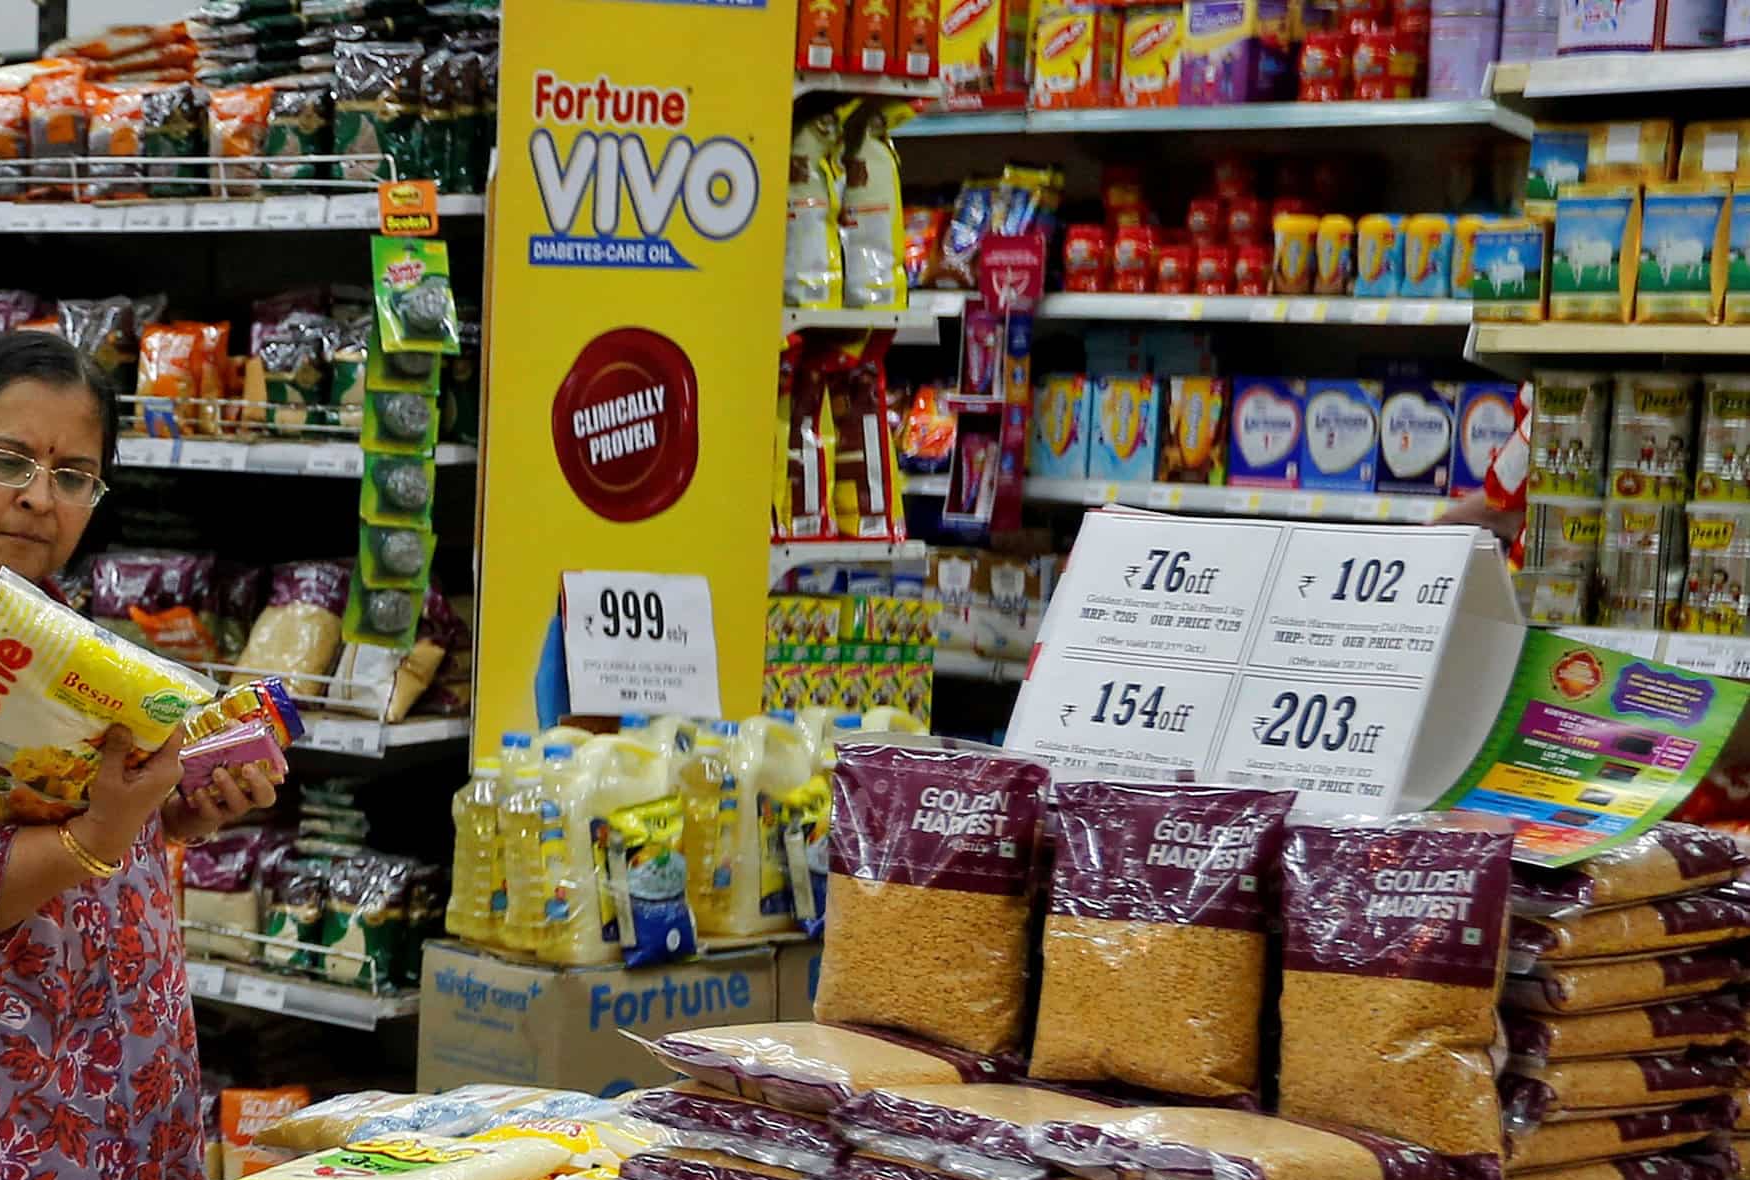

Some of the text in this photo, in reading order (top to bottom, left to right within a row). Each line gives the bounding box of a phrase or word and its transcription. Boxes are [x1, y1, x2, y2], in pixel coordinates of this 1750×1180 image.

[534, 72, 686, 128] Fortune
[529, 128, 760, 242] VIVO
[533, 240, 675, 264] DIABETES-CARE OIL
[573, 384, 666, 438] CLINICALLY
[588, 418, 656, 465] PROVEN
[1141, 549, 1191, 593] 76
[1185, 567, 1220, 594] off
[1331, 558, 1405, 602] 102
[1416, 576, 1455, 605] off
[599, 588, 665, 641] 999
[1079, 607, 1109, 621] MRP:
[1150, 614, 1172, 627] OUR
[1176, 616, 1212, 630] PRICE
[1274, 630, 1305, 645] MRP:
[1342, 636, 1365, 649] OUR
[1368, 637, 1403, 650] PRICE
[62, 670, 123, 712] Besan
[1090, 680, 1166, 729] 154
[1158, 704, 1194, 733] off
[1261, 691, 1357, 751] 203
[1348, 725, 1385, 753] off
[920, 786, 1011, 815] GOLDEN
[1318, 779, 1354, 795] PRICE
[911, 808, 1008, 836] HARVEST
[1153, 819, 1256, 848] GOLDEN
[1146, 843, 1251, 871] HARVEST
[1374, 868, 1476, 893] GOLDEN
[1366, 894, 1474, 922] HARVEST
[589, 970, 750, 1033] Fortune
